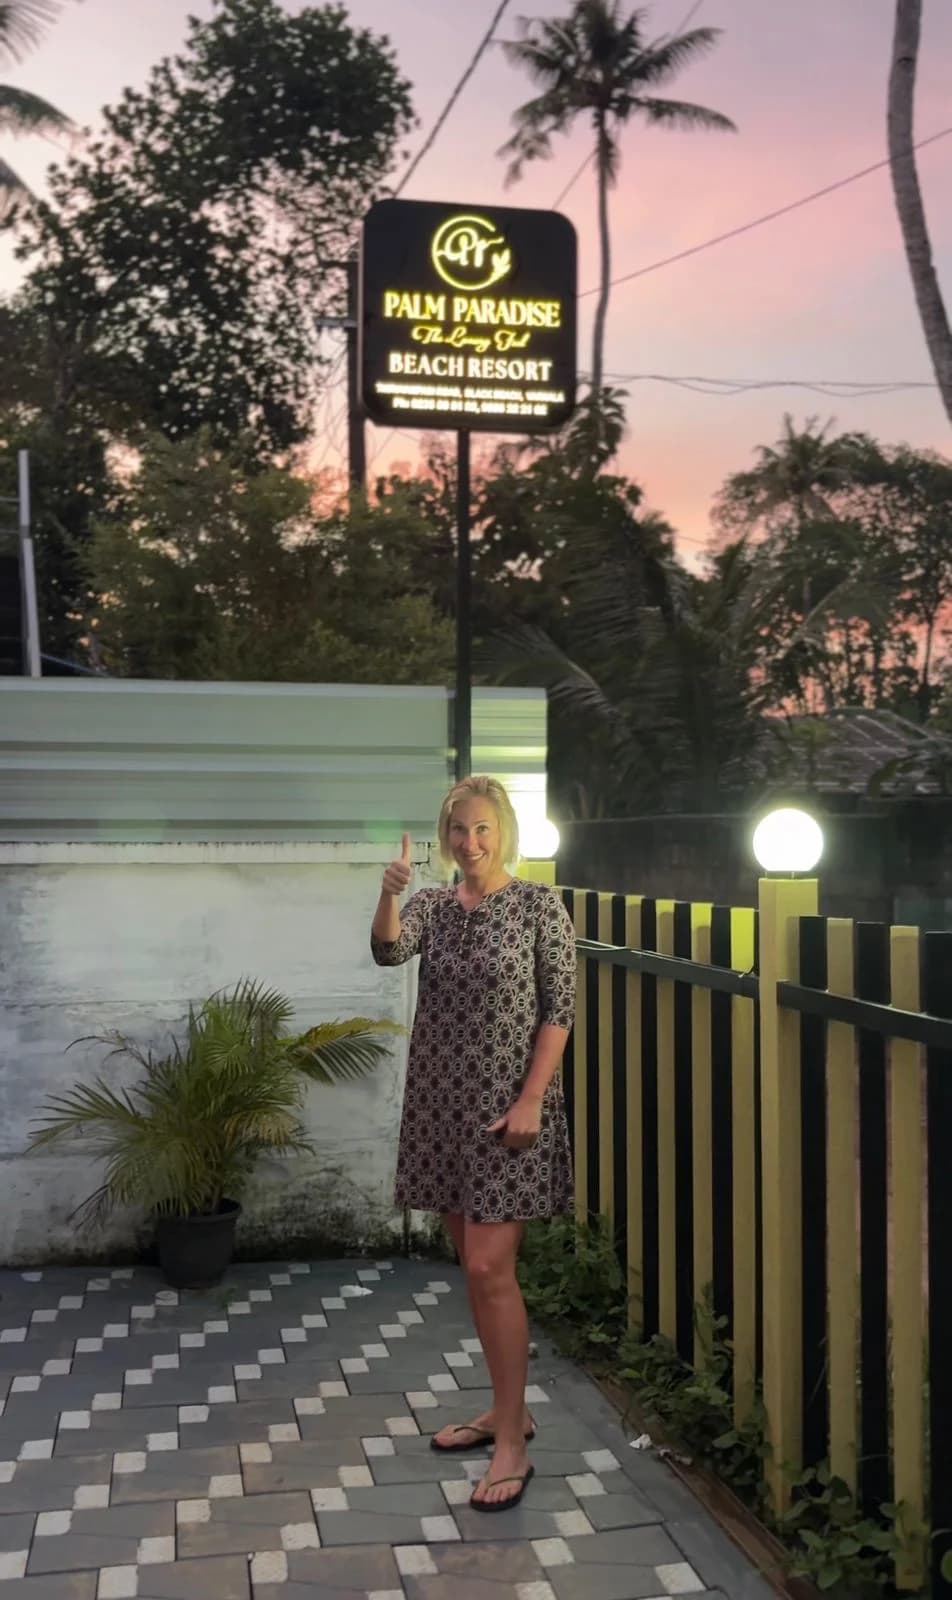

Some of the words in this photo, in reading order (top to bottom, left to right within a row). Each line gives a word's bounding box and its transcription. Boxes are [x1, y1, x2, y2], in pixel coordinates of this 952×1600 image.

[384, 292, 446, 321] PALM
[453, 297, 561, 327] PARADISE
[389, 352, 464, 378] BEACH
[467, 358, 553, 381] RESORT
